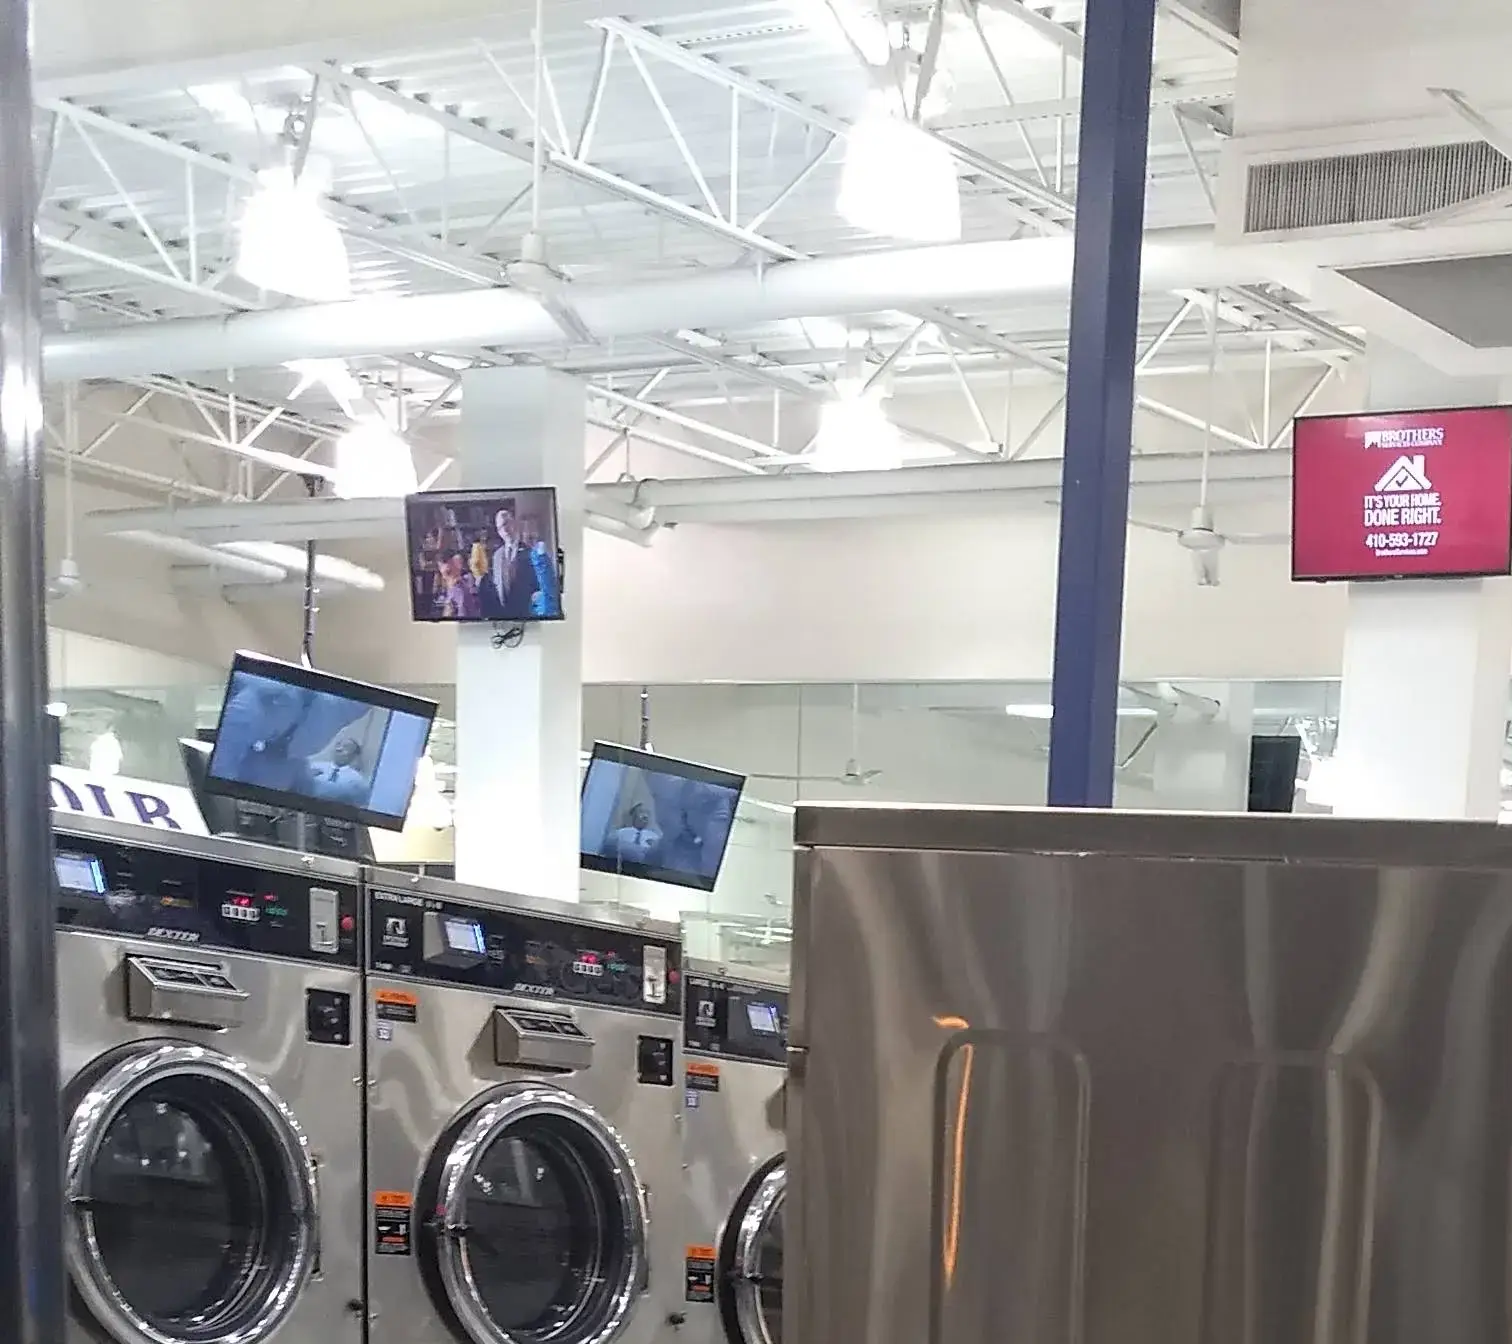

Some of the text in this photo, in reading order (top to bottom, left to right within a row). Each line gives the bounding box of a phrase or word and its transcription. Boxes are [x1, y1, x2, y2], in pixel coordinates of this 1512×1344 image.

[1382, 428, 1444, 442] BROTHERS
[1364, 495, 1383, 508] IT'S
[1384, 494, 1410, 507] YOUR
[1364, 507, 1442, 526] DONE RIGHT.
[1366, 532, 1438, 547] 410-593-1727
[147, 927, 201, 942] DEXTER
